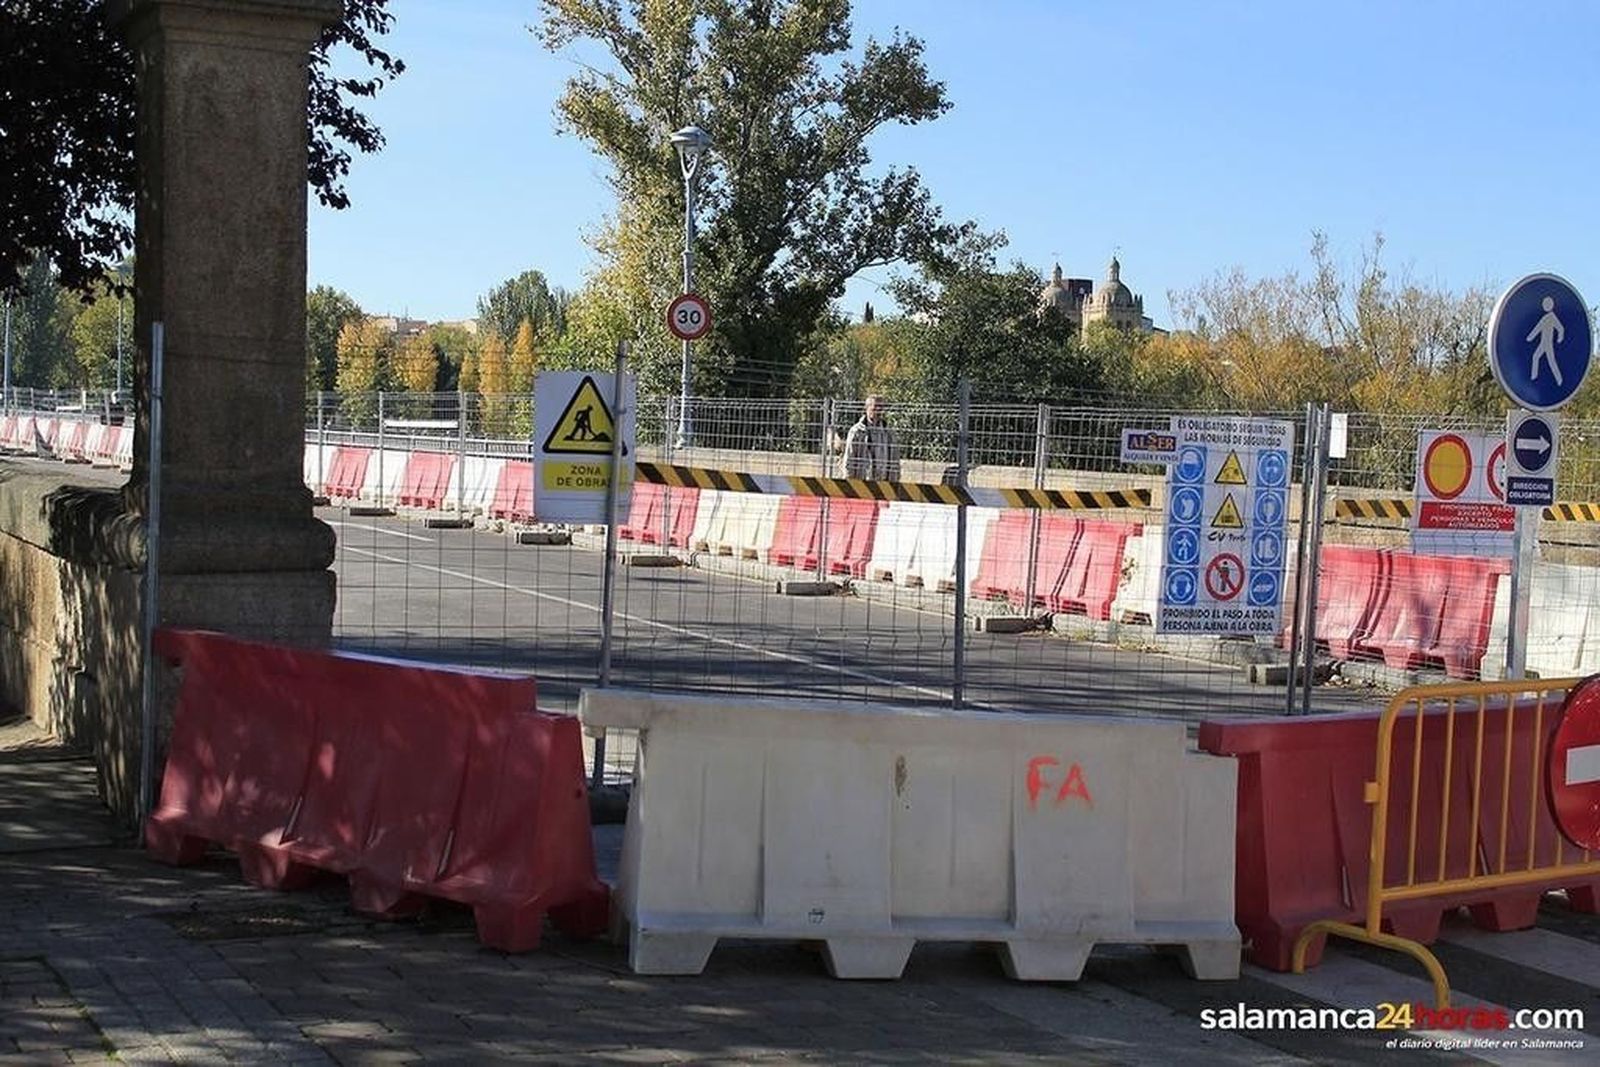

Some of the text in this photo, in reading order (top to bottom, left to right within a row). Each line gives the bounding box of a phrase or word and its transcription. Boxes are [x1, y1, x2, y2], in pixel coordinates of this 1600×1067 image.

[677, 309, 701, 325] 30
[1177, 419, 1286, 436] ES OBLIGATORIO SEGUIR TODAS
[1129, 432, 1175, 451] ALSER
[1184, 432, 1282, 447] LAS NORMAS DE SEGURIDAD
[570, 464, 601, 476] ZONA
[556, 476, 572, 487] DE
[1162, 608, 1275, 620] PROHIBIDO EL PASO A TODA
[1162, 620, 1274, 631] PERSONA AJENA A LA OBRA
[1024, 755, 1095, 812] FA
